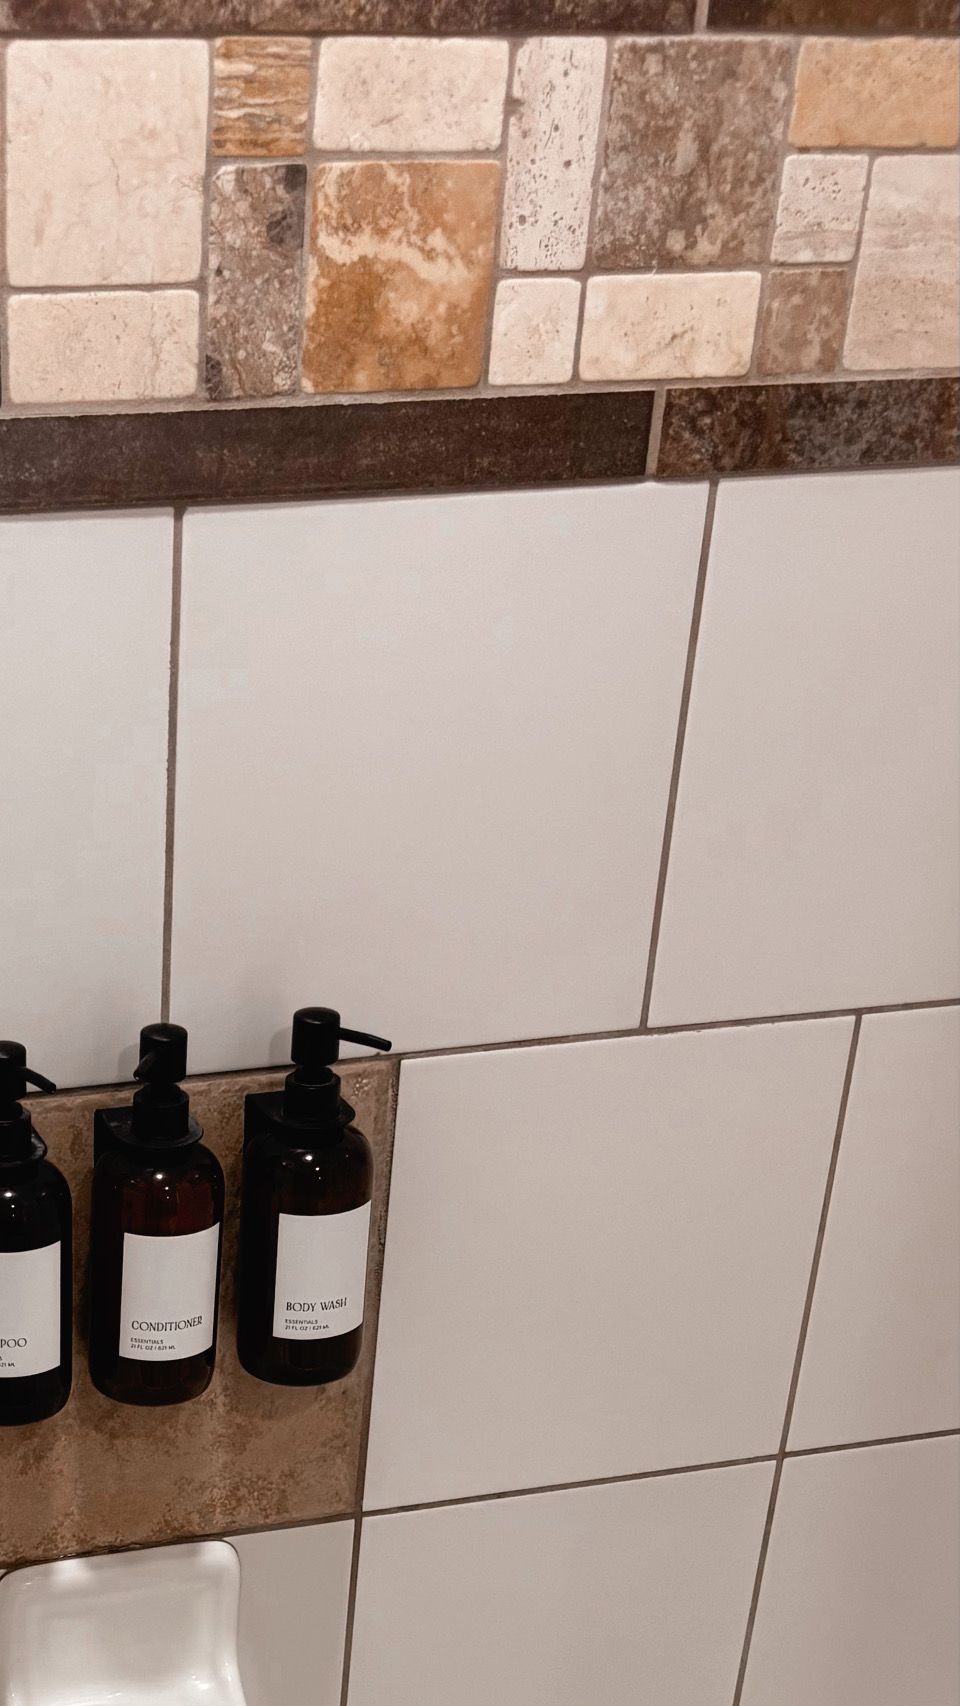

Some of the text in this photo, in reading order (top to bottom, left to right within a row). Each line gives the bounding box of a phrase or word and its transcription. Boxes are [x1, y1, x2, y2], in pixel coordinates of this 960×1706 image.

[286, 1297, 347, 1312] BODY WASH
[131, 1315, 203, 1332] CONDITIONER
[130, 1337, 164, 1345] ESSENTIALS
